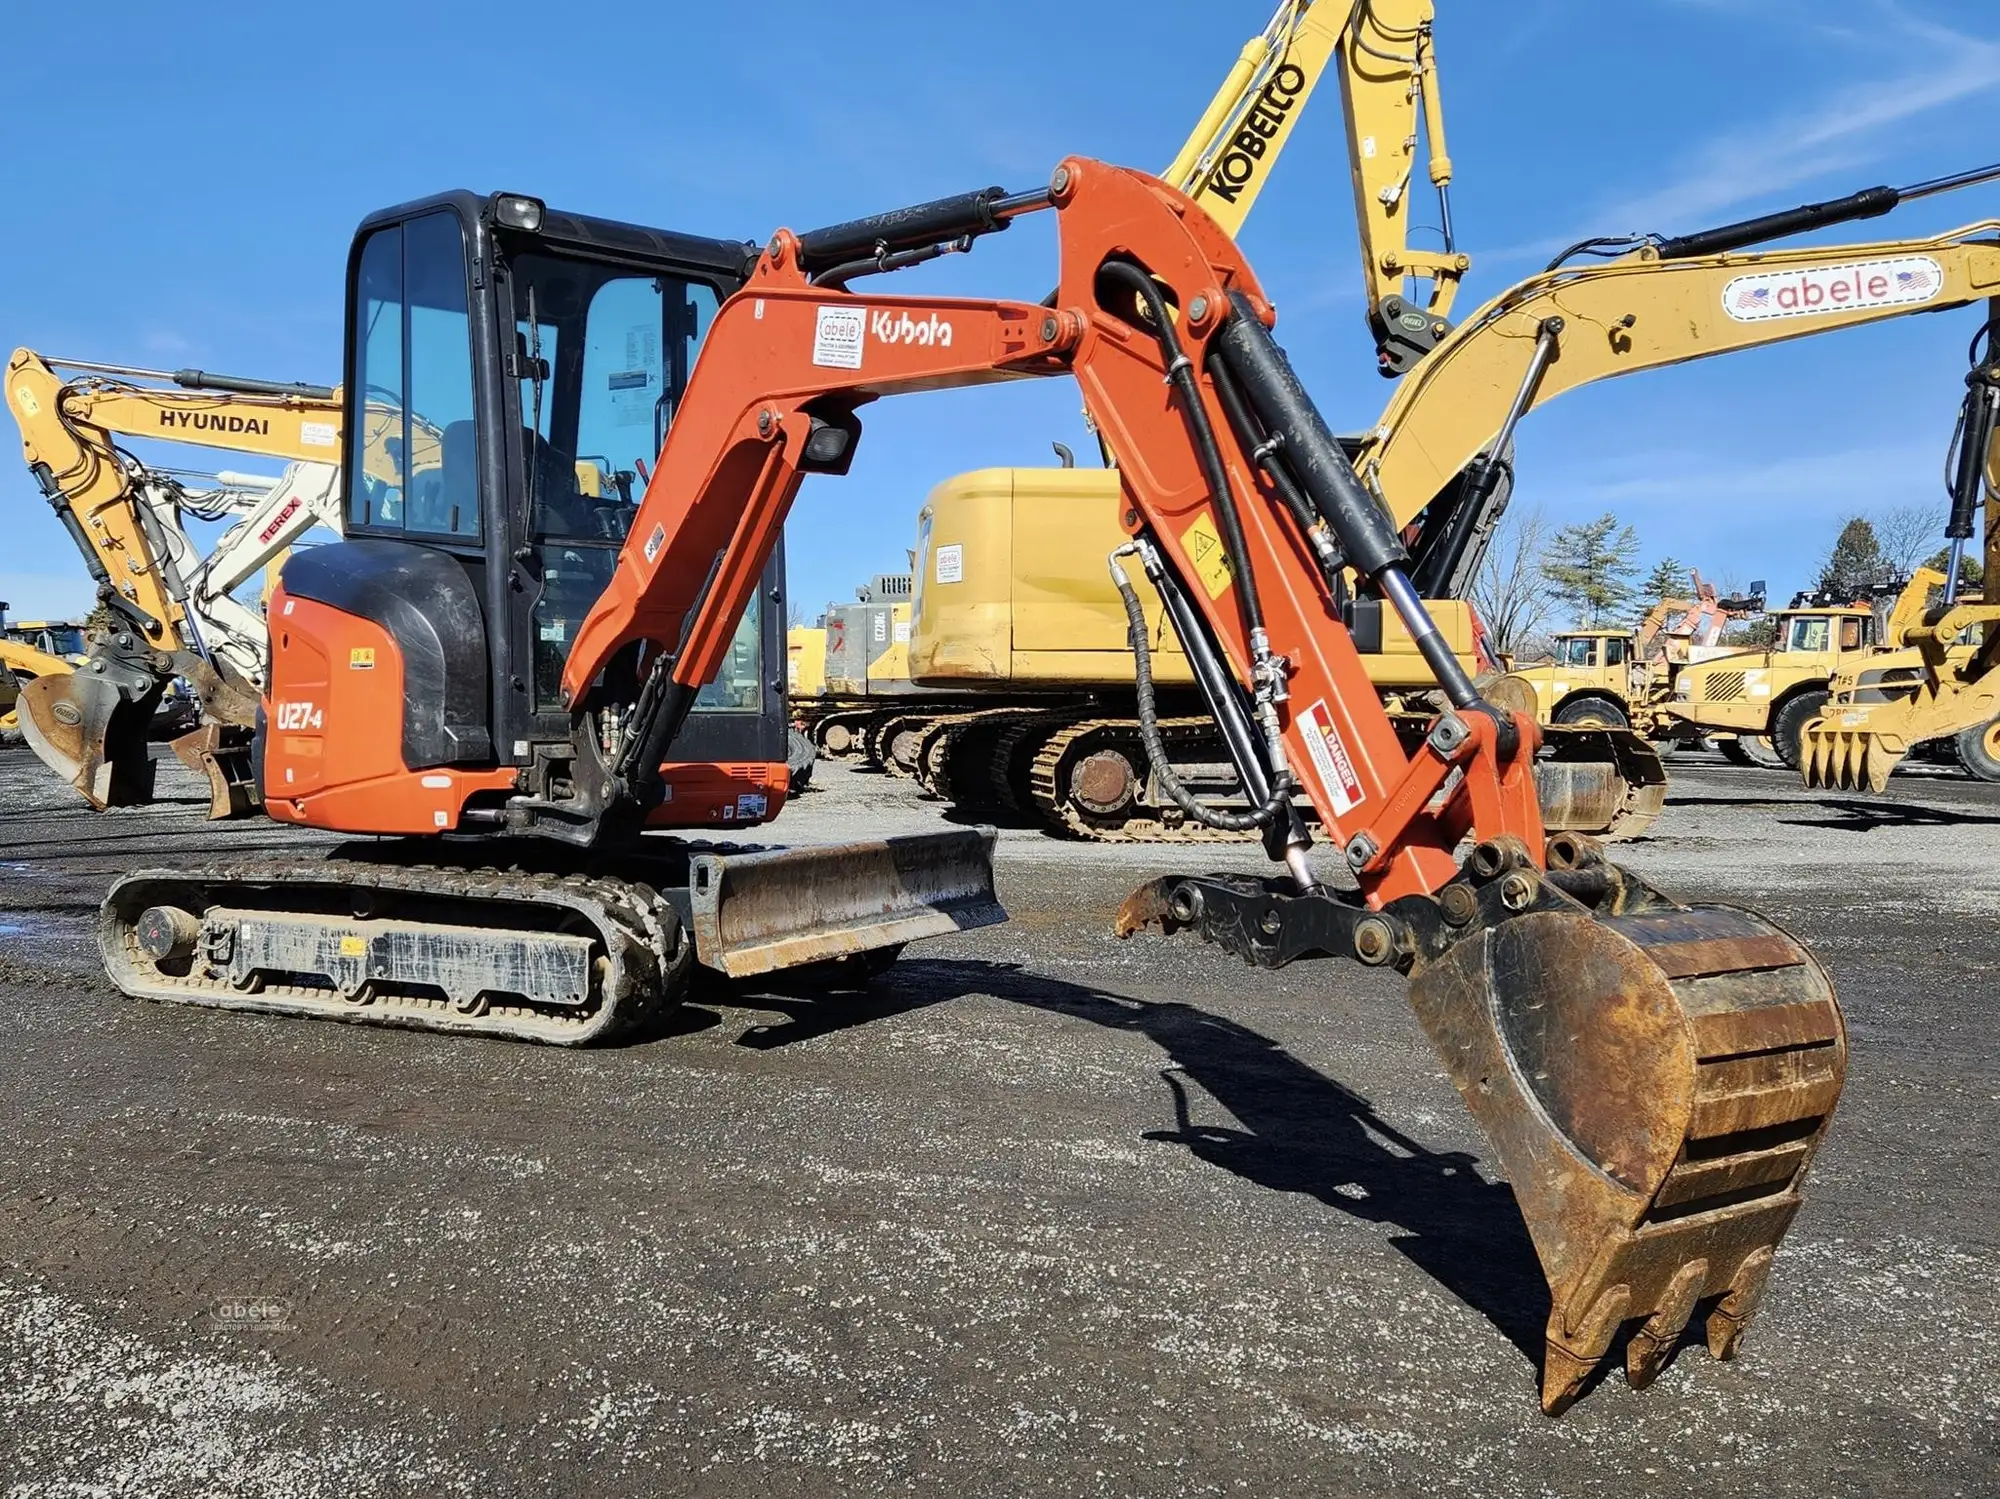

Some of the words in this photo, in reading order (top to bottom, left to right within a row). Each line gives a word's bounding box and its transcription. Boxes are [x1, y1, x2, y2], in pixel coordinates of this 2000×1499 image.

[1208, 63, 1305, 205] KOBELCO
[1776, 270, 1889, 310] abele
[824, 320, 856, 337] abele
[871, 310, 952, 347] Kubota
[160, 410, 269, 435] HYUNDAI
[259, 498, 301, 542] TEREX
[277, 702, 323, 730] U27-4
[1325, 732, 1355, 789] DANGER
